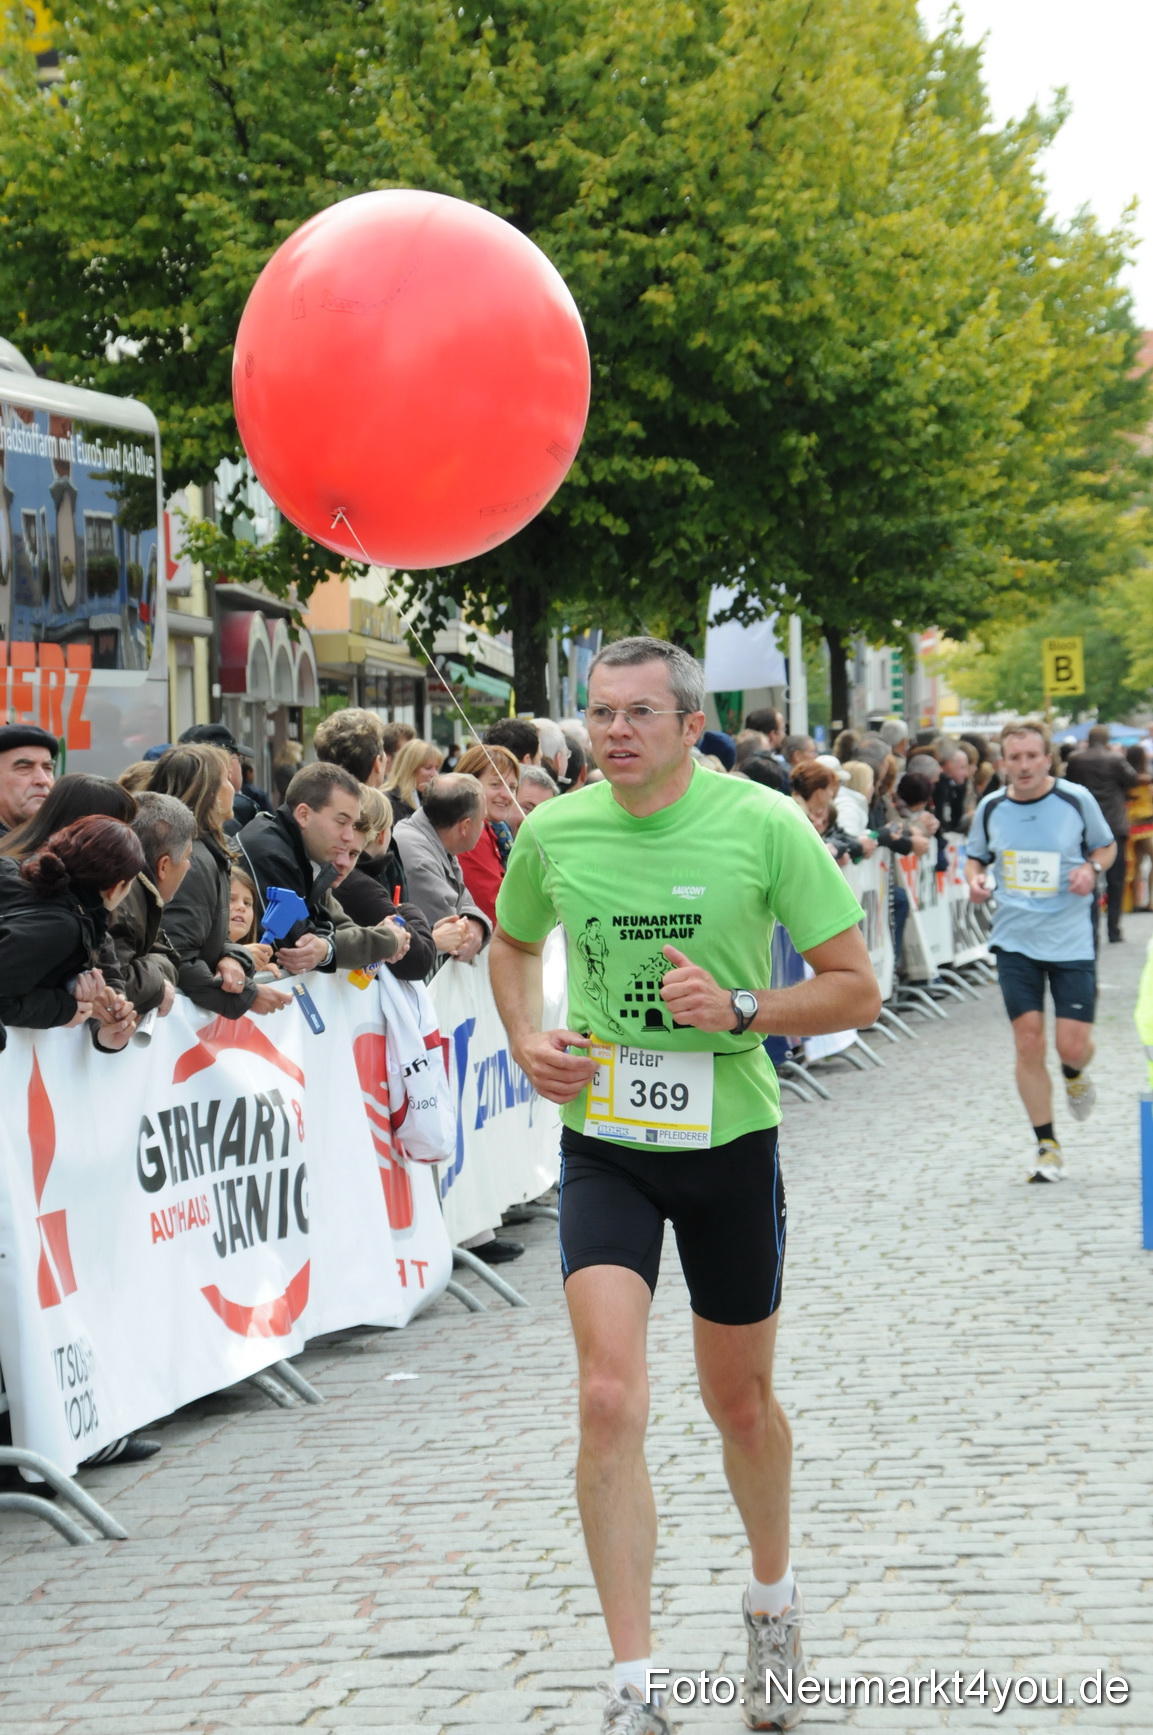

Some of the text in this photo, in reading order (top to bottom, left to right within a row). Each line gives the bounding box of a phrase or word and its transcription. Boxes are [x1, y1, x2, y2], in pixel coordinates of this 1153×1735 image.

[59, 431, 75, 462] mit
[103, 440, 121, 471] und
[123, 443, 134, 473] Ad
[135, 445, 154, 478] Blue
[1056, 656, 1073, 681] B
[1023, 870, 1049, 883] 372
[671, 886, 706, 895] SAUCONY
[612, 914, 702, 927] NEUMARKTER
[619, 928, 695, 940] STADTLAUF
[620, 1045, 664, 1068] Peter
[629, 1079, 689, 1112] 369
[136, 1088, 290, 1194] GERHART
[659, 1130, 708, 1141] PFLEIDERER
[212, 1161, 310, 1259] JÄNIG
